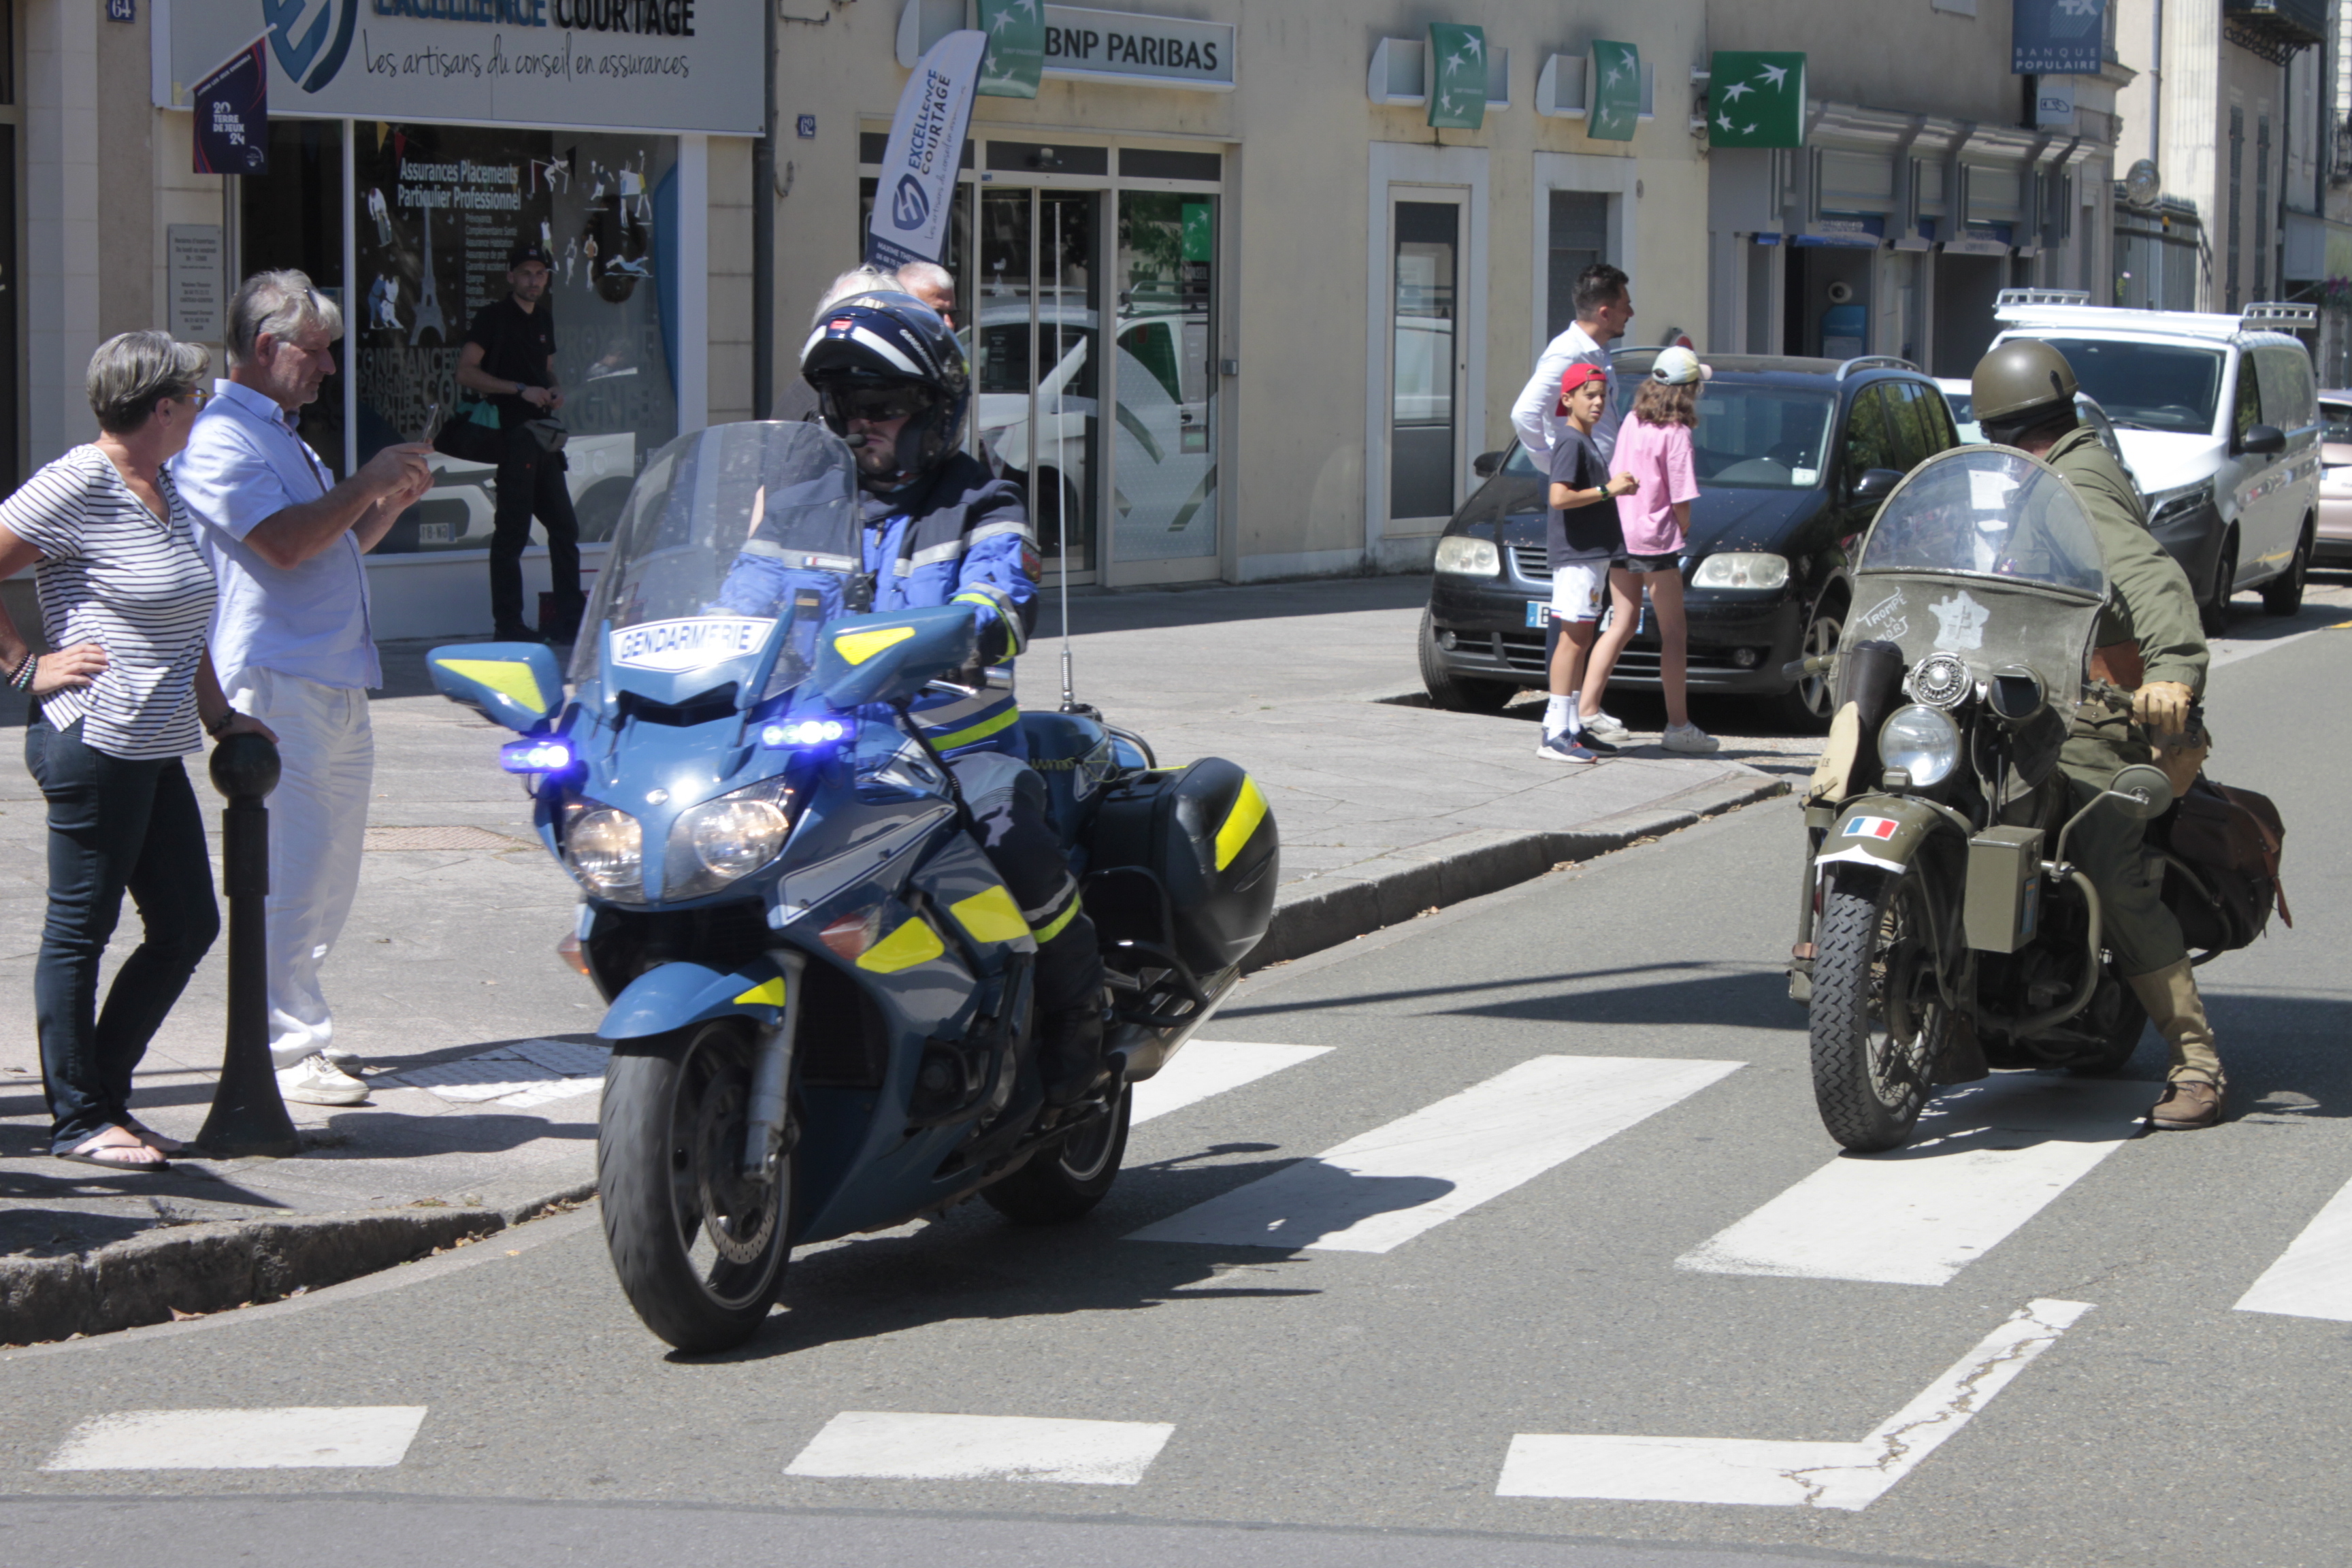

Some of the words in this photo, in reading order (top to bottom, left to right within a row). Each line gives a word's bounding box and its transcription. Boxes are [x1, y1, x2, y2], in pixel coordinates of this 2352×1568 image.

[112, 0, 131, 18] 64
[363, 29, 398, 78] Les
[403, 46, 483, 78] artisans
[487, 33, 510, 78] du
[515, 31, 572, 82] conseil
[576, 54, 595, 74] en
[599, 54, 691, 78] assurances
[1045, 27, 1099, 59] BNP
[1107, 33, 1218, 71] PARIBAS
[2016, 48, 2096, 58] BANQUE
[2016, 61, 2096, 69] POPULAIRE
[213, 114, 239, 123] TERRE
[800, 117, 813, 135] 62
[908, 69, 939, 170] EXCELLENCE
[921, 74, 951, 176] COURTAGE
[213, 124, 224, 132] DE
[225, 124, 244, 132] JEUX
[230, 133, 245, 145] 24
[399, 157, 459, 182] Assurances
[460, 159, 519, 184] Placements
[397, 184, 451, 208] Particulier
[453, 186, 521, 210] Professionnel
[877, 241, 899, 257] MAXIME
[1856, 587, 1908, 627] TROMPE
[1883, 616, 1896, 629] LA
[621, 623, 753, 659] GENDARMERIE
